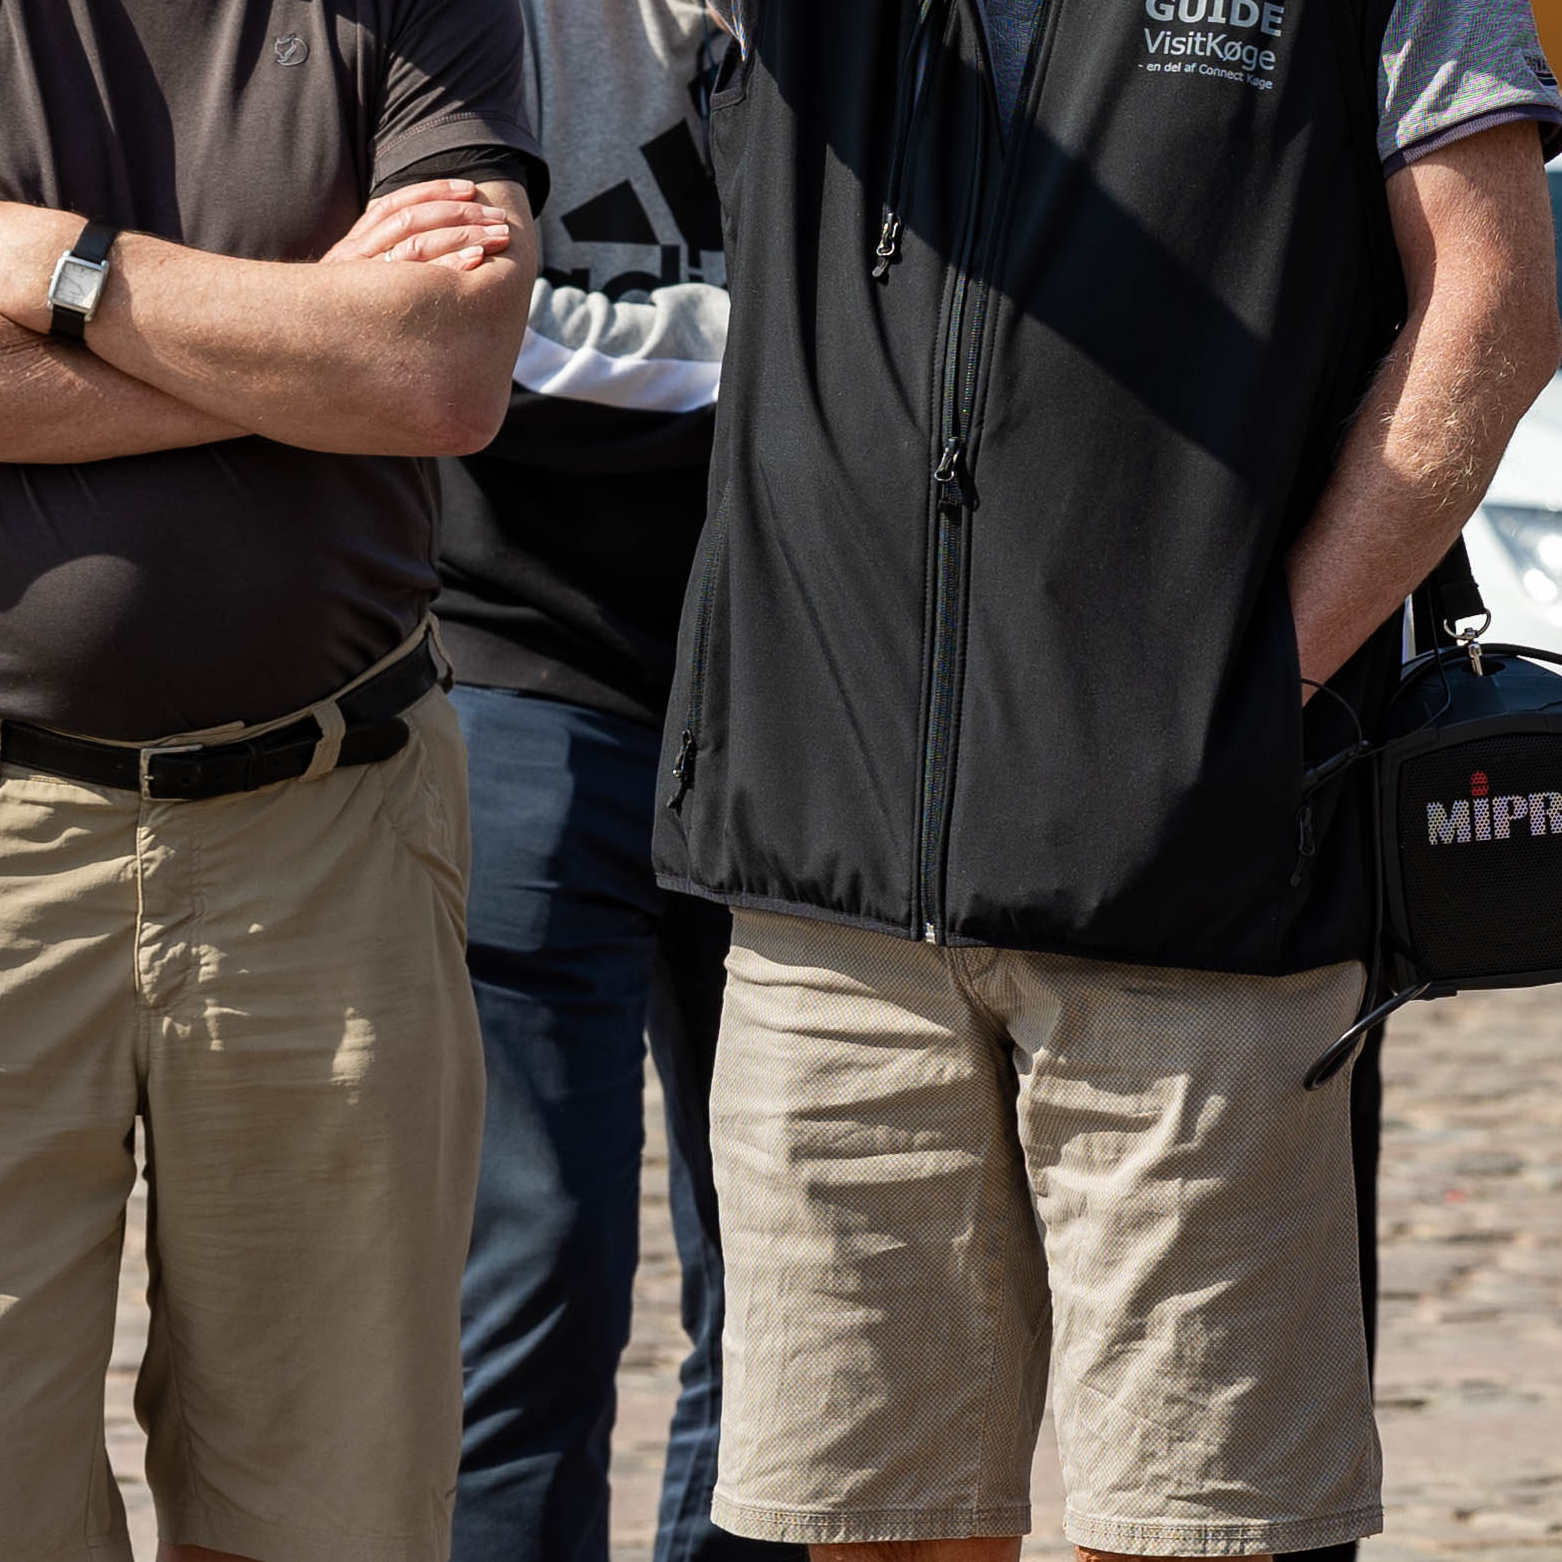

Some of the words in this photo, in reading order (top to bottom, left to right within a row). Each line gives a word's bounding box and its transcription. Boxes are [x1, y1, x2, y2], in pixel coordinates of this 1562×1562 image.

[1144, 28, 1275, 71] VisitKøge
[1146, 62, 1161, 72] en
[1164, 61, 1181, 73] del
[1184, 62, 1197, 74] af
[1198, 64, 1244, 81] Connect
[1246, 73, 1273, 90] Køge
